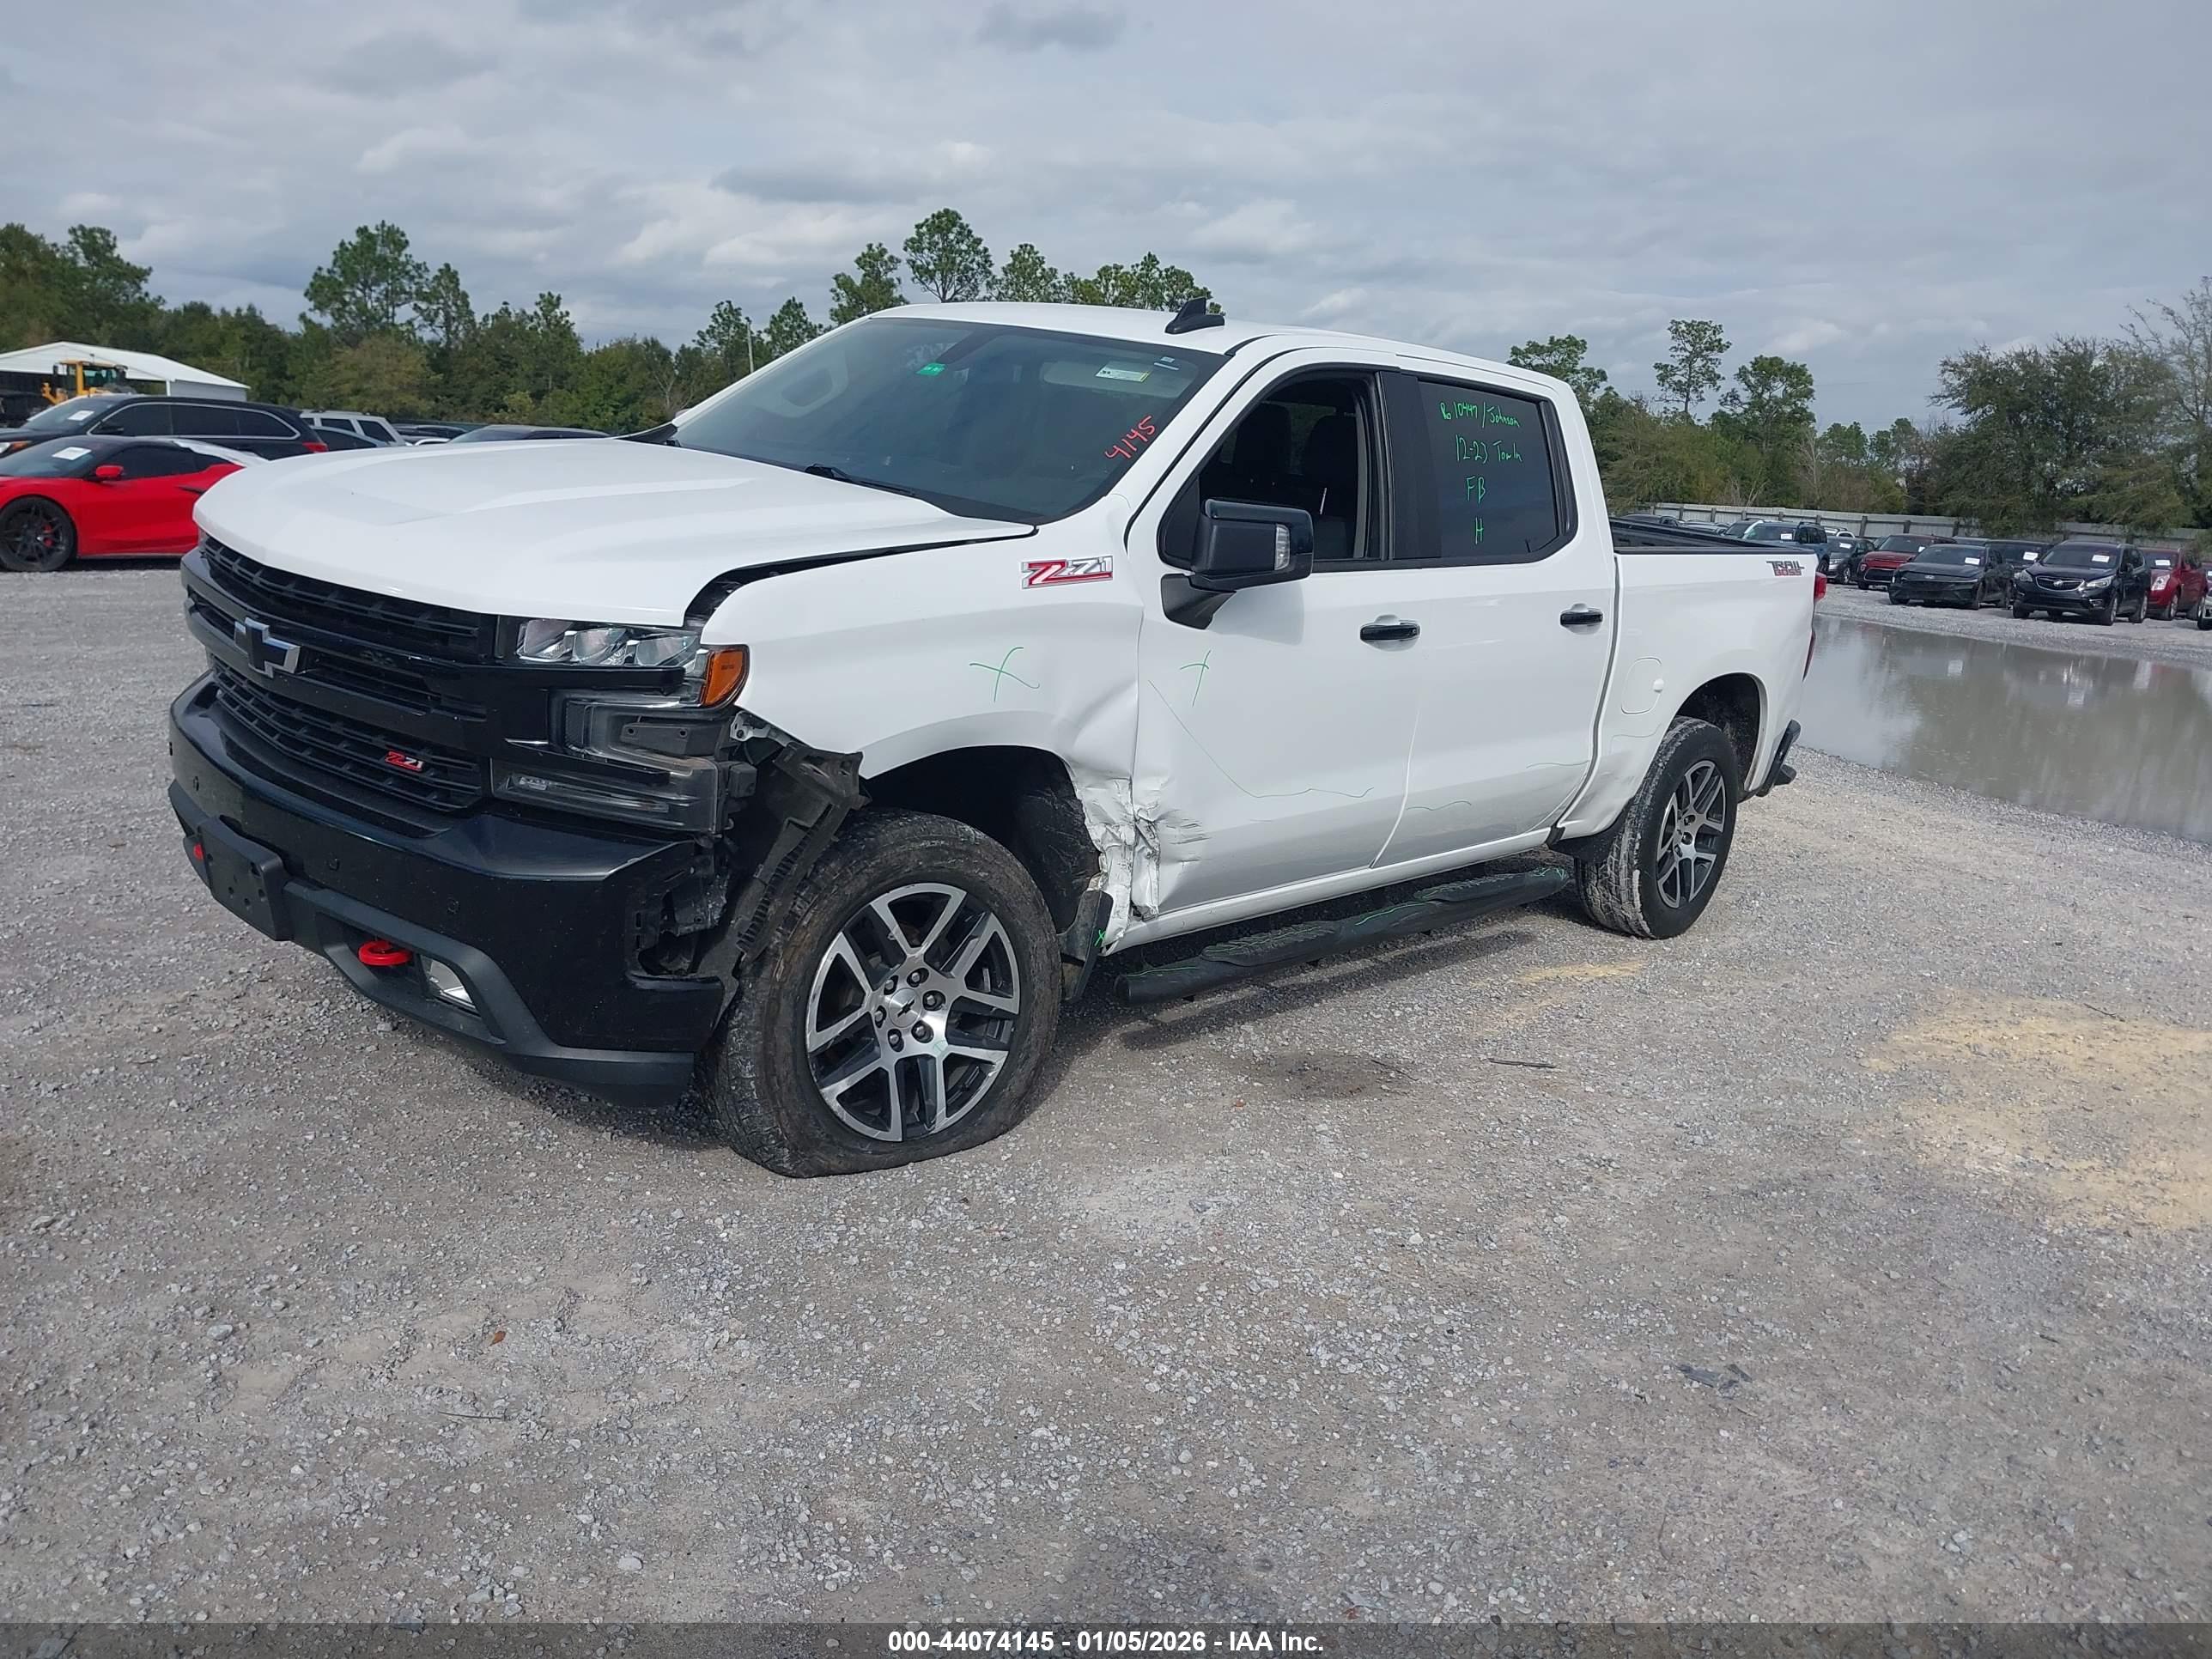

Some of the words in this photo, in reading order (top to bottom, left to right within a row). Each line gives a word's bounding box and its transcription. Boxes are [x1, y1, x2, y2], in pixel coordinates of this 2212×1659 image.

[1104, 415, 1156, 459] 4145
[1022, 556, 1113, 589] Z71
[1765, 561, 1805, 569] TRAIL
